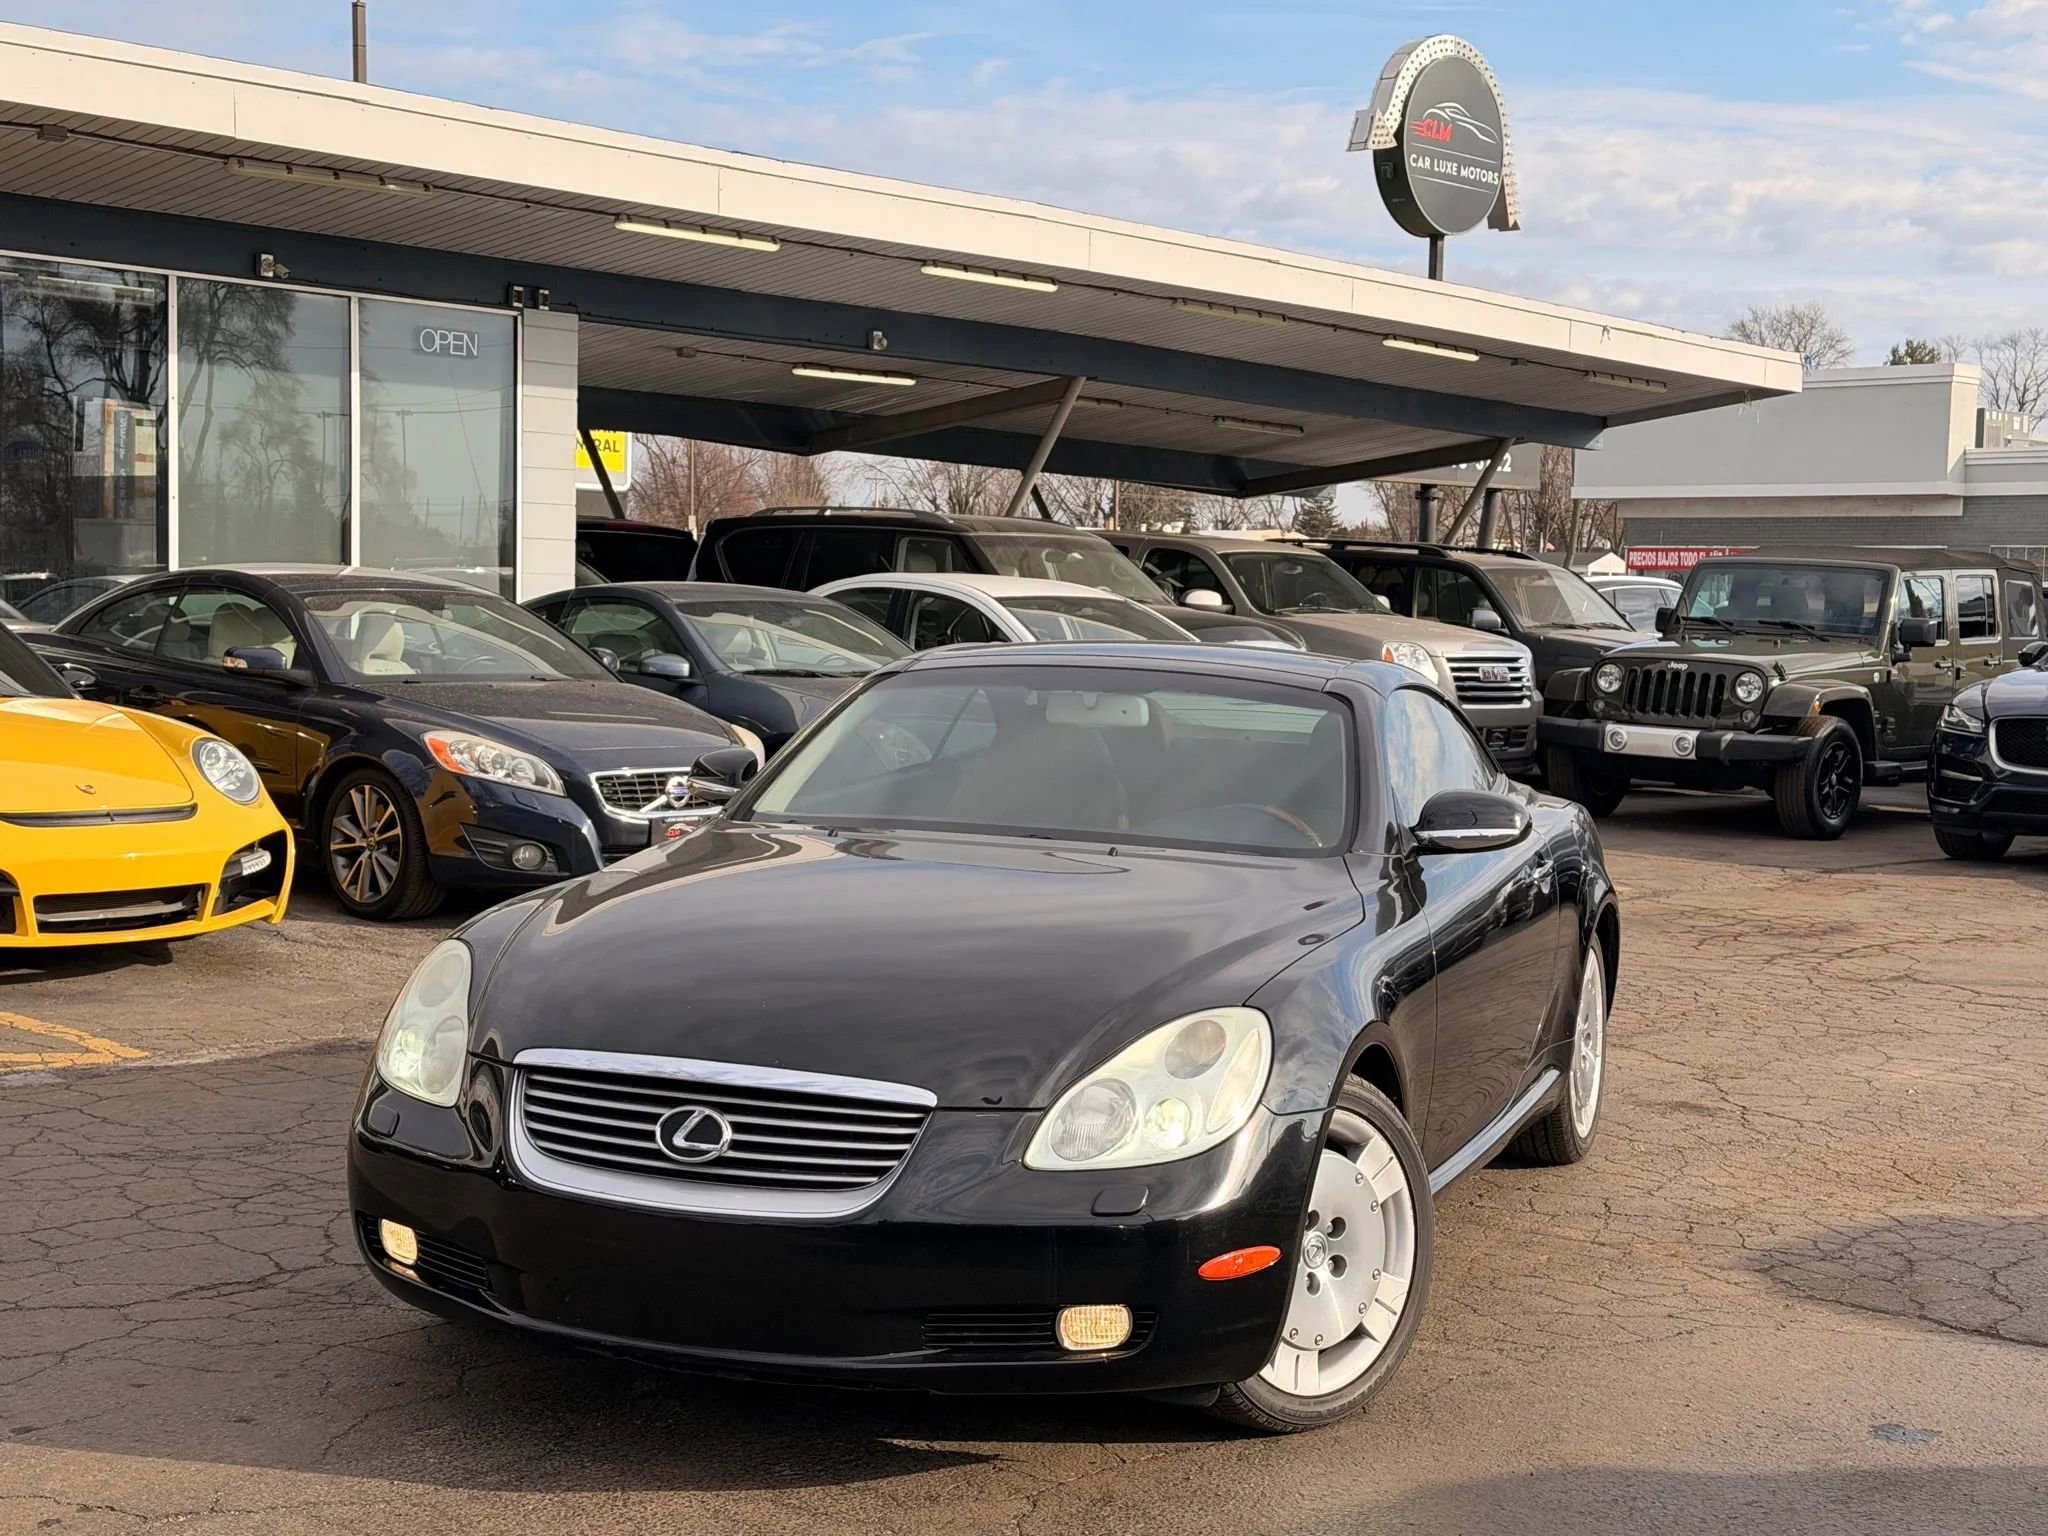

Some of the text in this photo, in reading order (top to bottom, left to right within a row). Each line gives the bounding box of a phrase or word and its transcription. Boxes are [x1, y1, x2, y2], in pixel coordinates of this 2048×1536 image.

[1422, 119, 1454, 143] CLM
[1410, 154, 1499, 185] CAR LUXE MOTORS
[420, 328, 478, 356] OPEN
[1629, 551, 1657, 566] PRECIOS
[1657, 551, 1678, 567] BAJOS
[1680, 551, 1698, 567] TODO
[1667, 660, 1689, 671] Jeep
